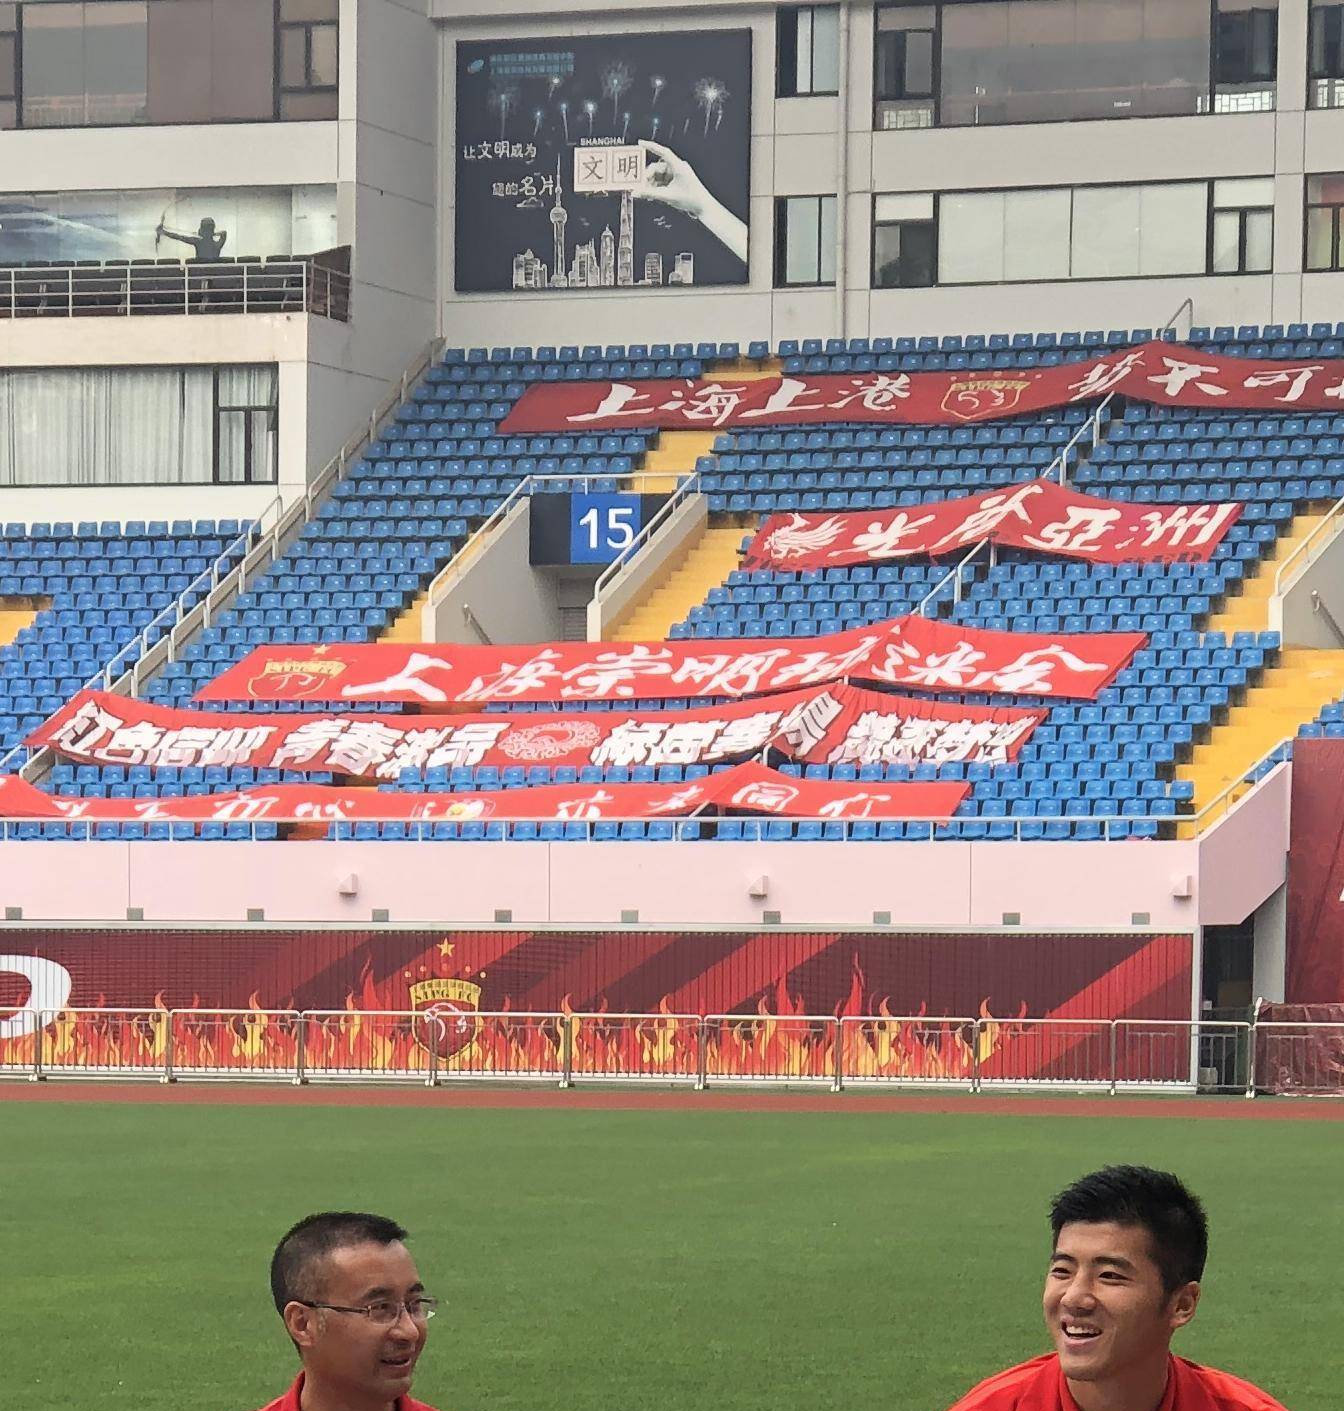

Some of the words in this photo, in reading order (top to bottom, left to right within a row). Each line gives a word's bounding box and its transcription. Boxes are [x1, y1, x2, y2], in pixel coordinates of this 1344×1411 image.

[580, 137, 625, 146] SHANGHAI
[582, 155, 639, 181] 文明
[567, 372, 912, 427] 上海上港
[579, 507, 634, 549] 15
